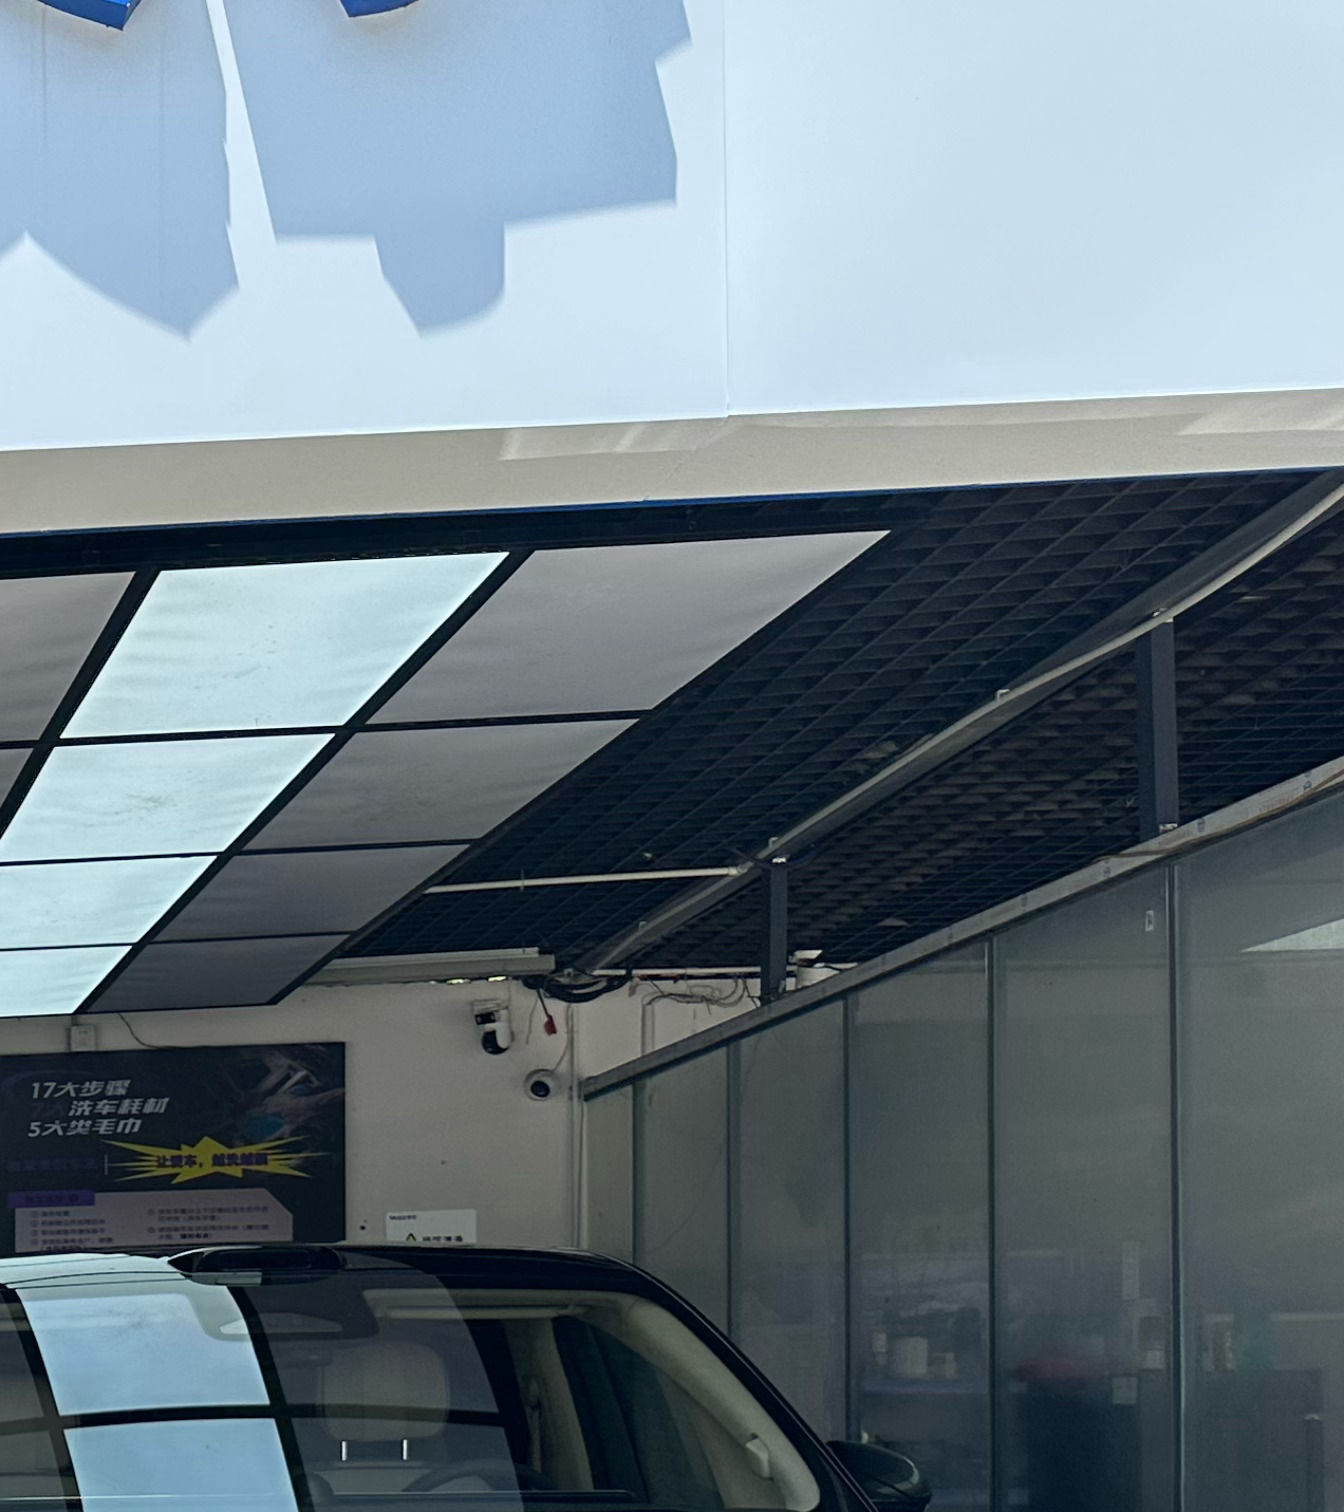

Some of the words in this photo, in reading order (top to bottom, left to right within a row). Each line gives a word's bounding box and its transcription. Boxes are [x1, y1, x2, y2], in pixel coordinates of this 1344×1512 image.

[31, 1079, 131, 1099] 17大步骤
[27, 1118, 142, 1138] 5大类毛巾
